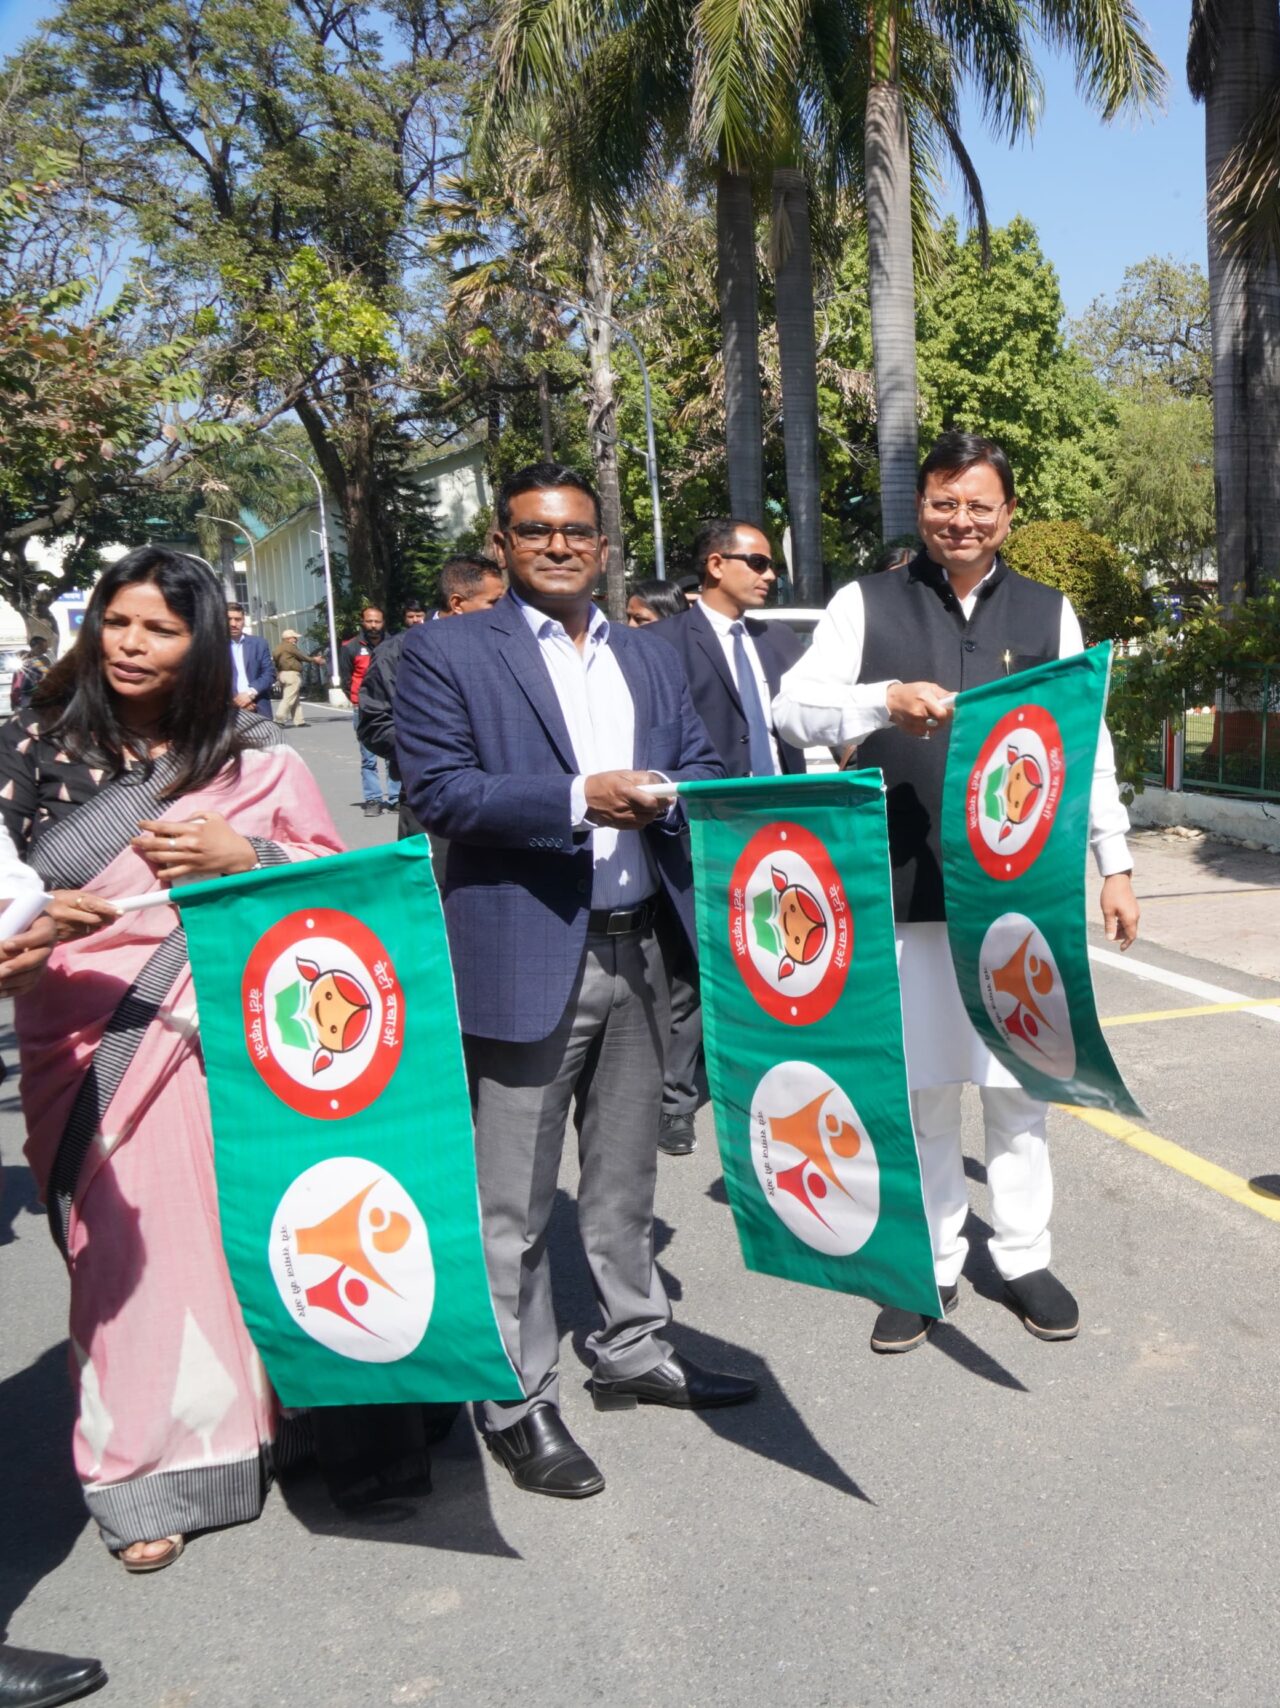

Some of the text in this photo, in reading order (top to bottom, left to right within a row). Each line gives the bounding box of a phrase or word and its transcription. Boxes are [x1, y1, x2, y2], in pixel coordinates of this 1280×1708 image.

[733, 887, 744, 912] बेटी
[828, 882, 848, 969] बेटी बचाओ
[248, 987, 264, 1013] बेटी
[373, 960, 399, 1047] बेटी बचाओ
